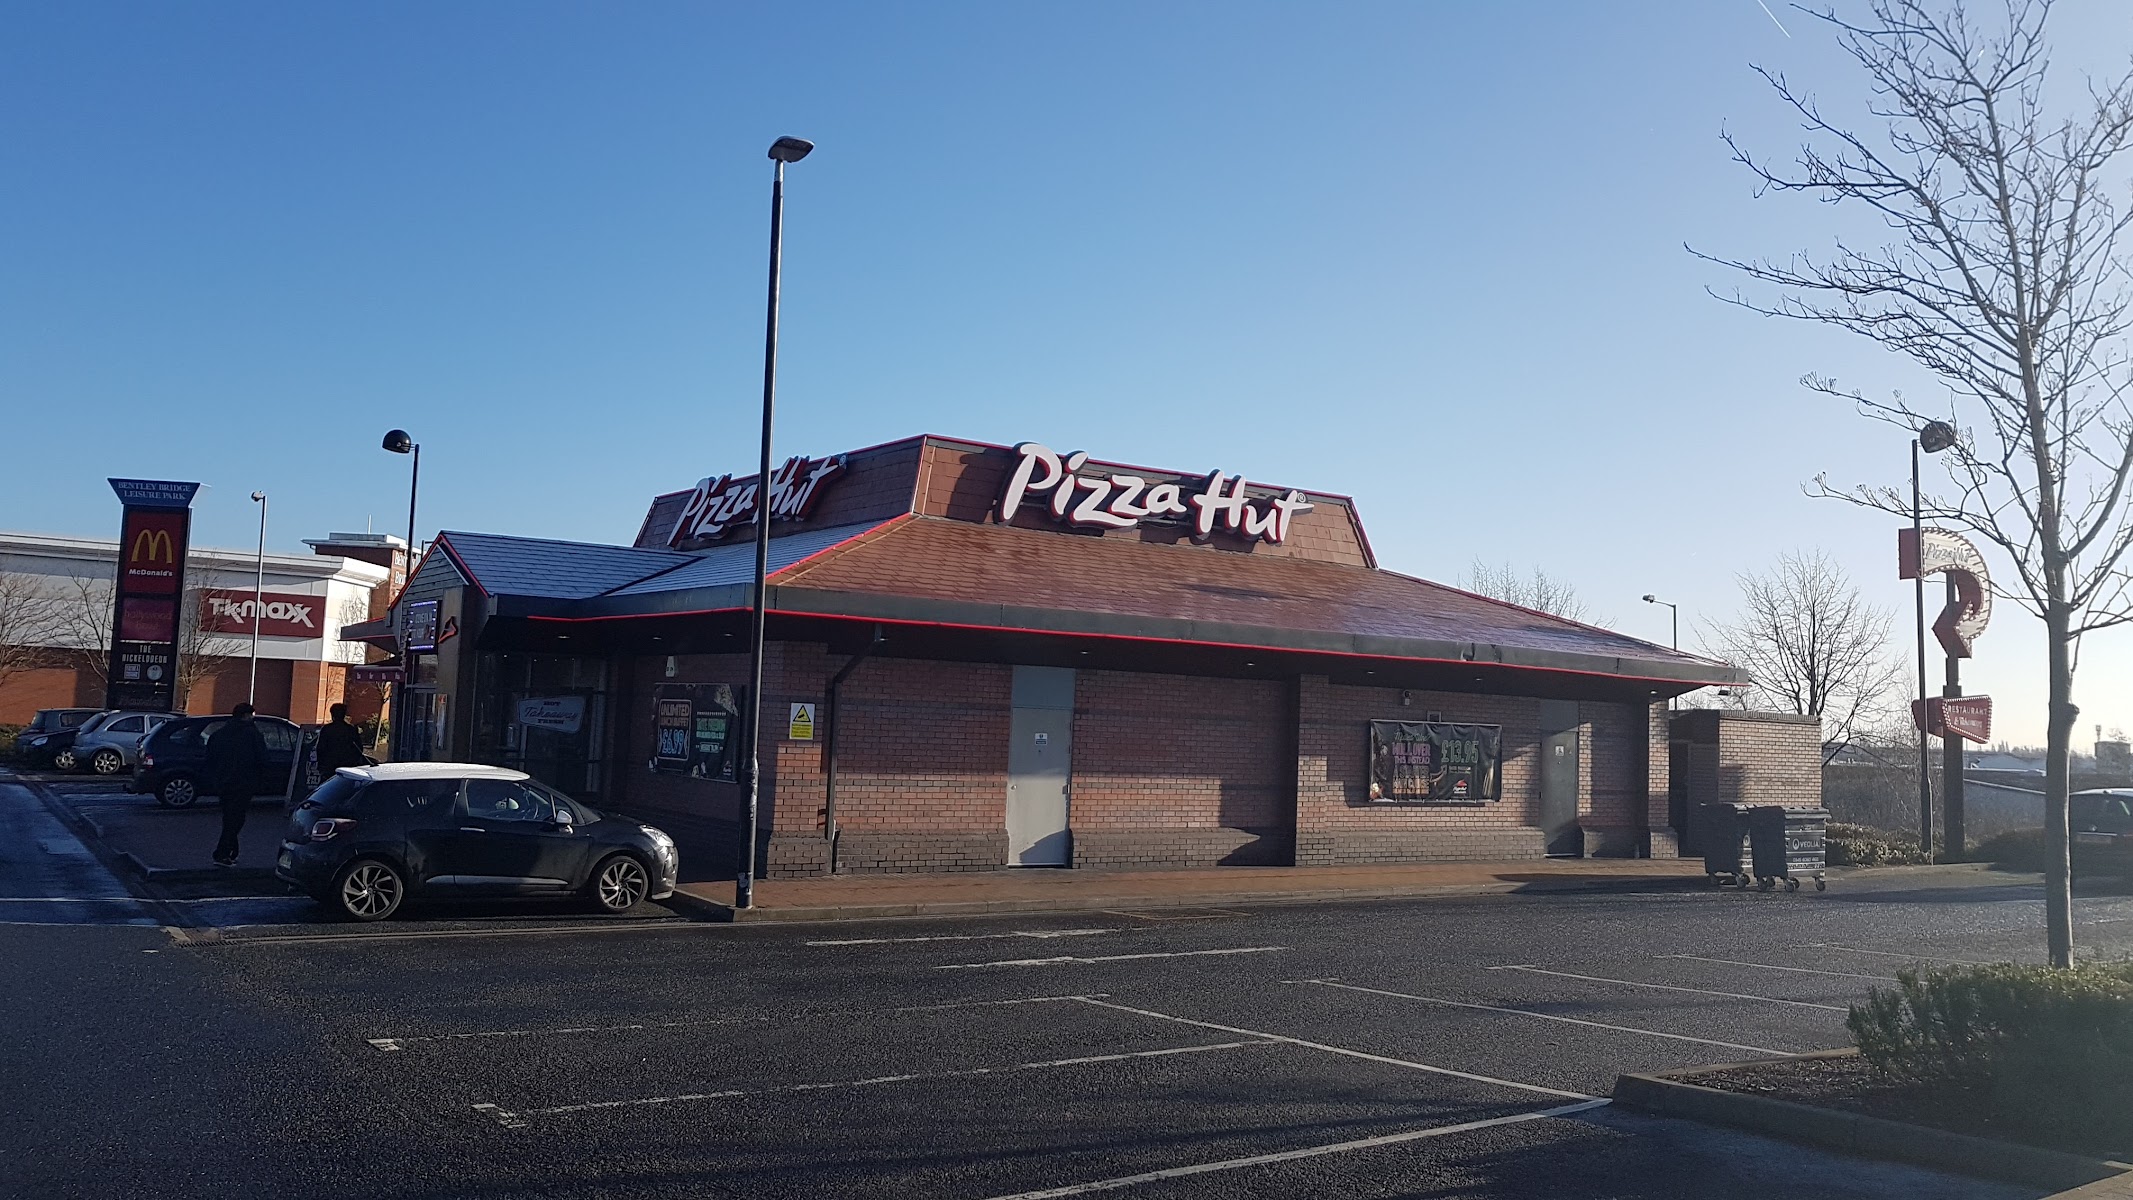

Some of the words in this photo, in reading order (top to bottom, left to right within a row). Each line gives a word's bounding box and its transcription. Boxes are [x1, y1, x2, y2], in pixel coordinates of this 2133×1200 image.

[119, 482, 157, 490] BENTLEY
[159, 483, 191, 491] BRIDGE
[1003, 443, 1187, 526] Pizza
[124, 490, 161, 498] LEISURE
[163, 492, 187, 500] PARK
[667, 474, 760, 546] Pizza
[128, 568, 173, 577] McDonald's
[122, 654, 168, 663] NICKELODEON
[524, 706, 578, 721] Takeaway
[660, 704, 690, 717] UNLIMITED
[1947, 704, 1988, 715] RESTAURANT
[1441, 740, 1480, 763] £13.95
[1394, 756, 1407, 764] THIS
